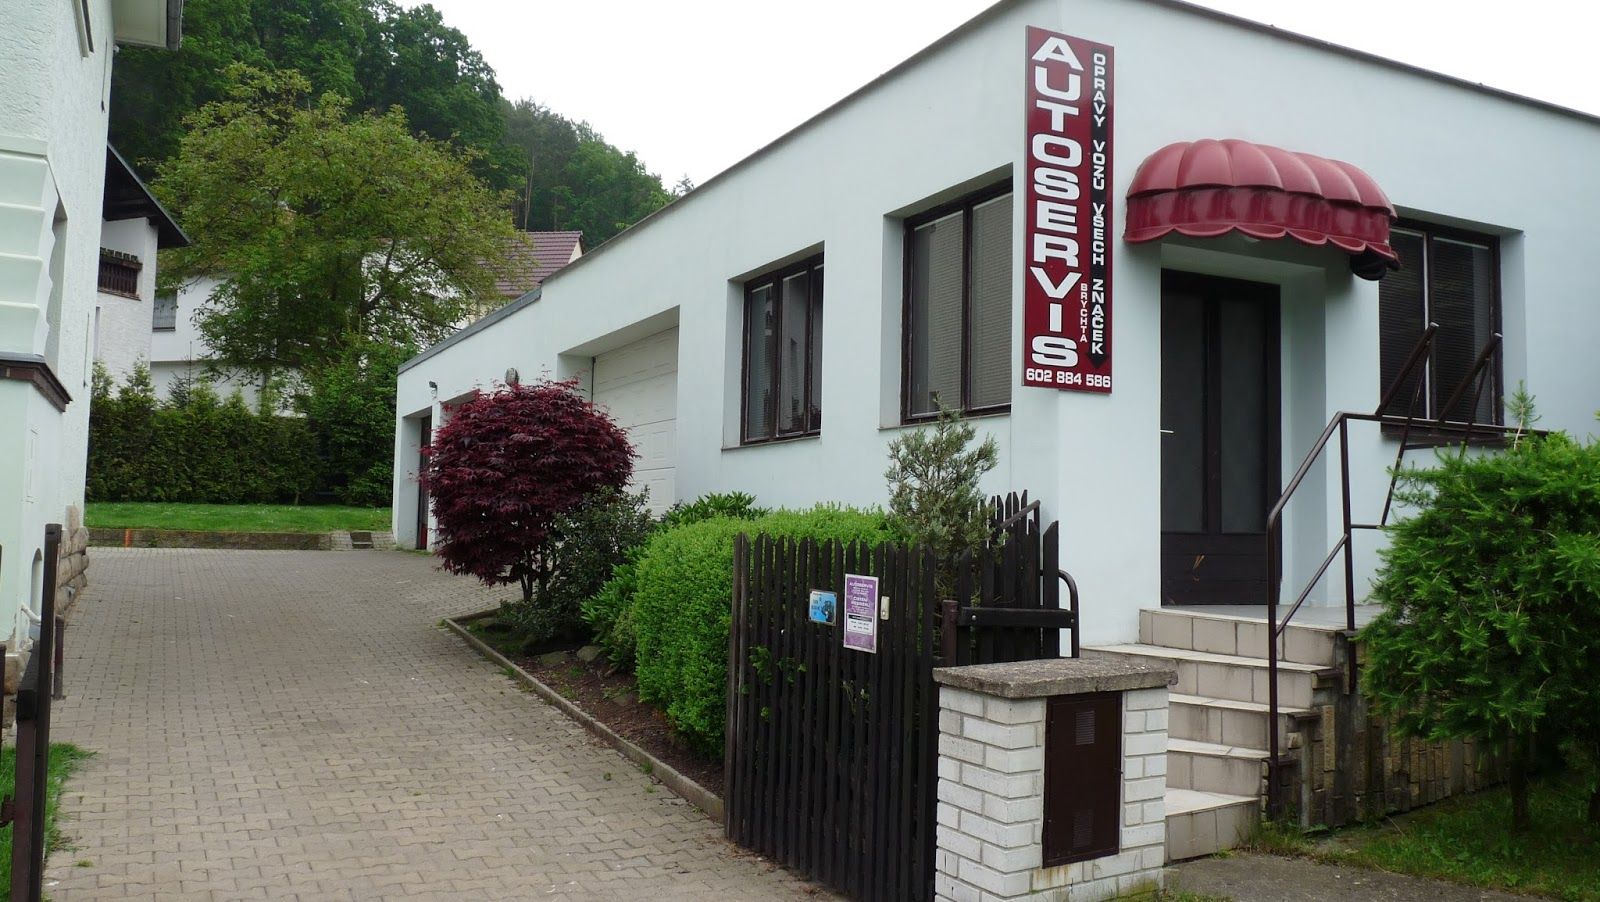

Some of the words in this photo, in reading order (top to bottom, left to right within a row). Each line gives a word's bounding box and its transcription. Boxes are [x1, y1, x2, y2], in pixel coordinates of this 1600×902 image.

[1093, 53, 1106, 127] OPRAVY
[1030, 36, 1084, 367] AUTOSERVIS
[1080, 282, 1088, 343] BRYCHTA
[1091, 278, 1105, 355] ZNAČEK
[1026, 368, 1053, 382] 602
[1056, 371, 1082, 385] 884
[1085, 373, 1111, 388] 586
